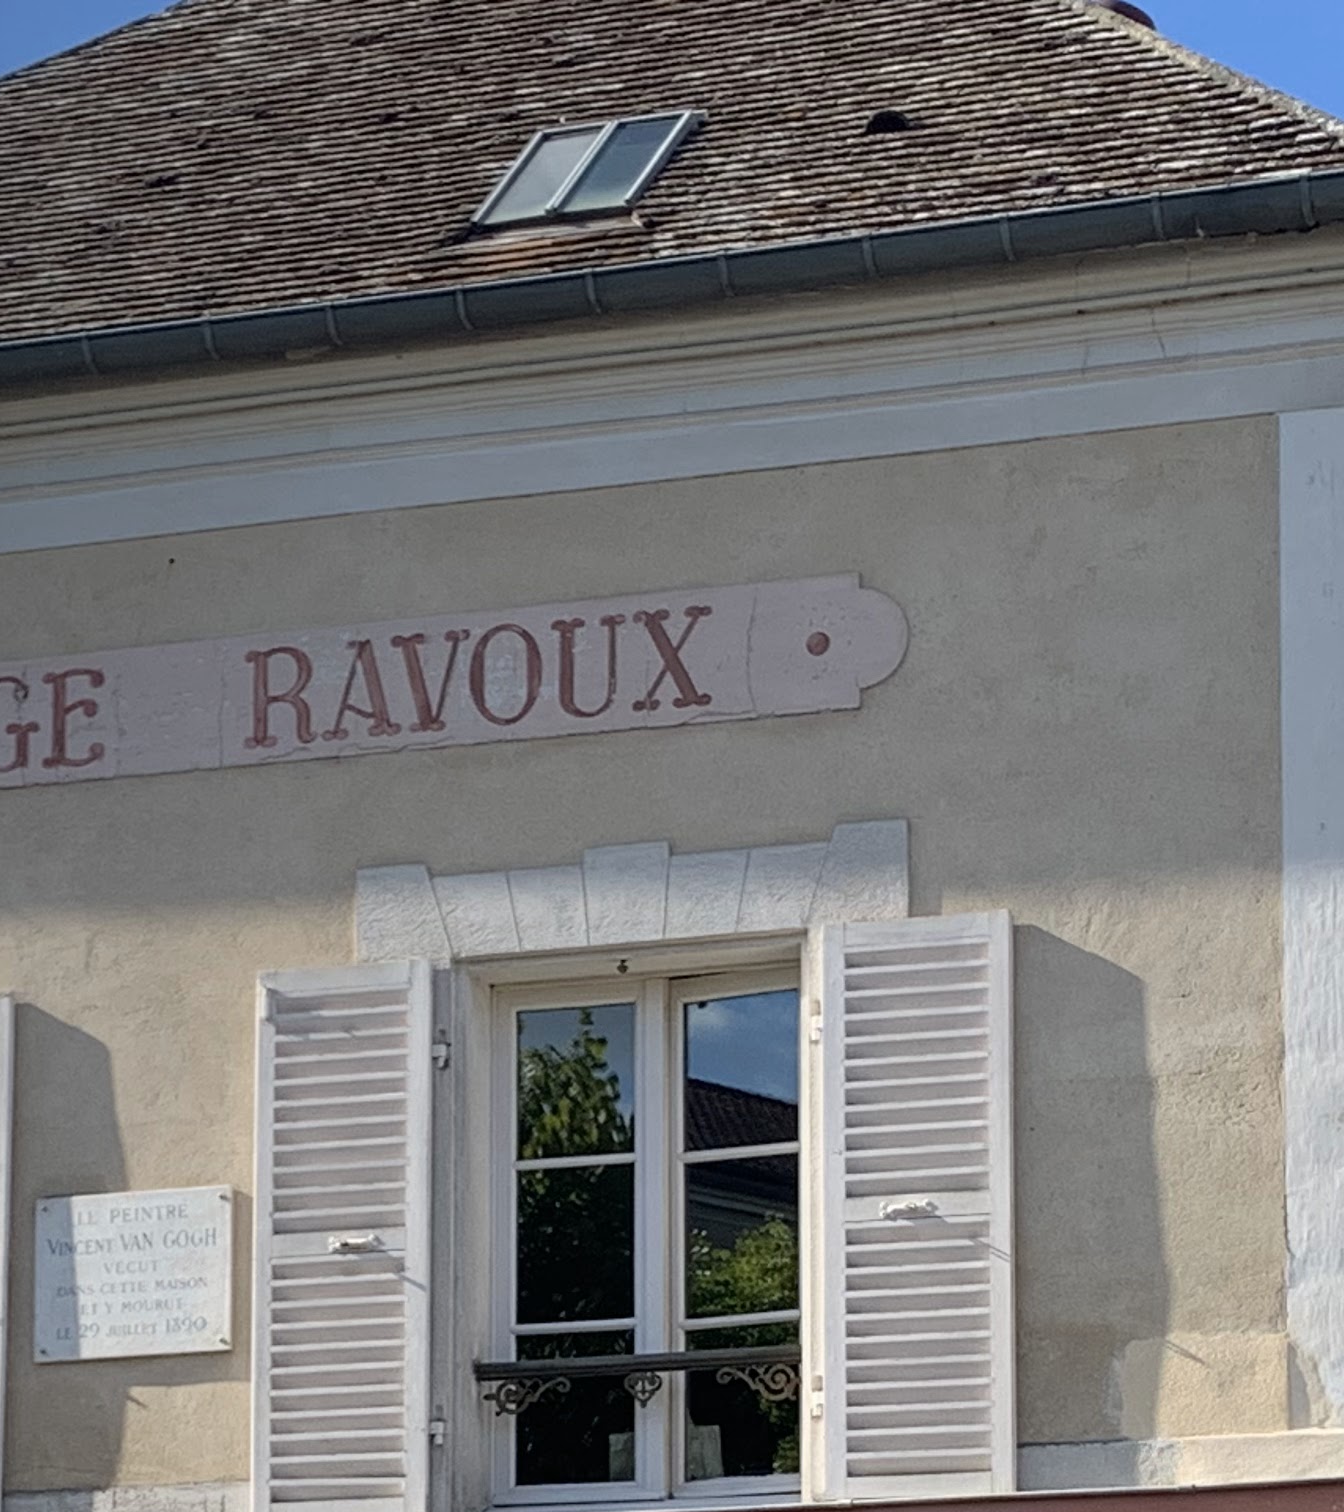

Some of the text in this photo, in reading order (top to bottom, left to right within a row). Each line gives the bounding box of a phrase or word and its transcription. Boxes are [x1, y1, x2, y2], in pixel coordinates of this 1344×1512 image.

[244, 606, 713, 748] RAVOUX
[110, 1204, 189, 1224] PEINTRE
[47, 1227, 218, 1257] VINCENT VAN GOGH
[56, 1276, 208, 1298] DANS CETTE MAISON
[57, 1327, 72, 1341] LE
[79, 1322, 100, 1339] 29
[165, 1315, 209, 1334] 1890
